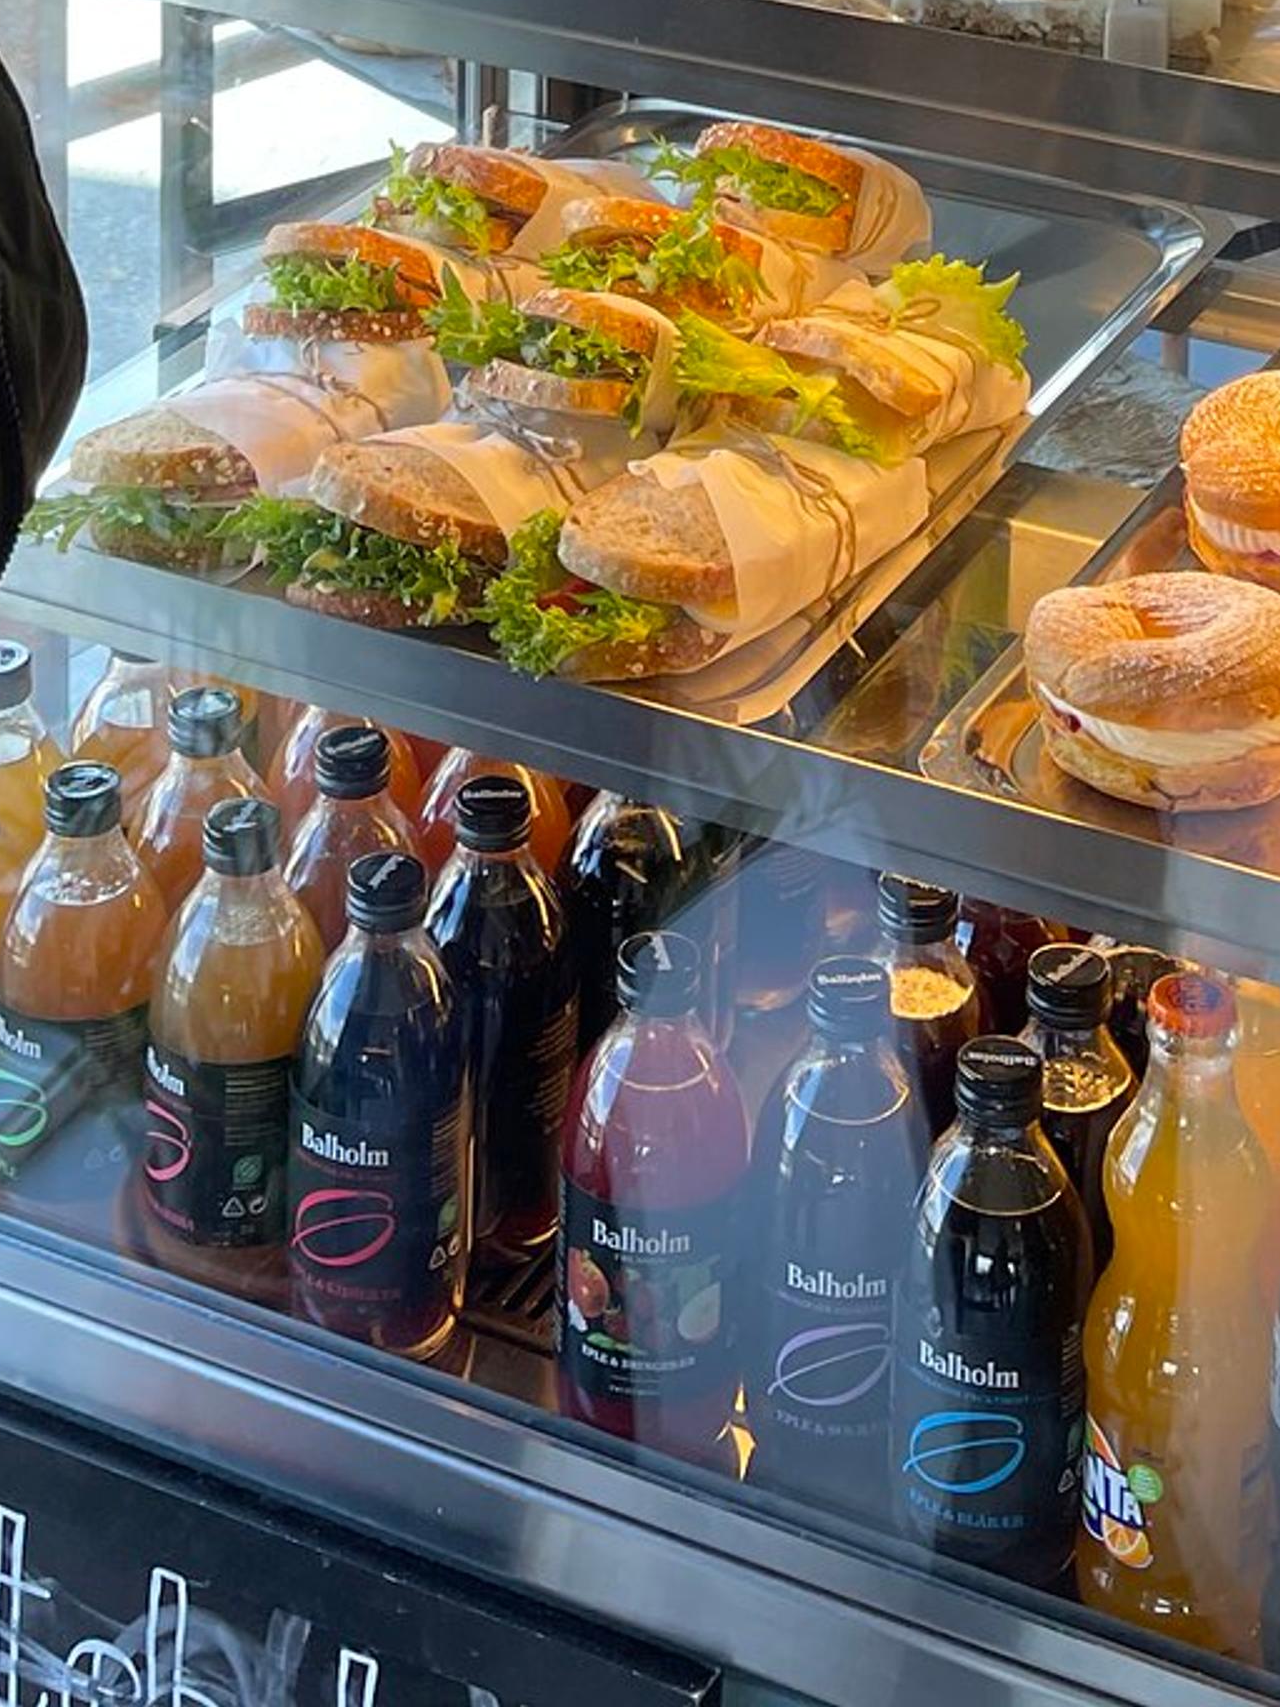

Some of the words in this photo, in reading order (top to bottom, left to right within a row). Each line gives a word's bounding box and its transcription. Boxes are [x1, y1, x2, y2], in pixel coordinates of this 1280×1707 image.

[302, 1121, 390, 1167] Balholm
[592, 1217, 691, 1255] Balholm
[786, 1261, 888, 1299] Balholm
[919, 1338, 1020, 1389] Balholm
[1082, 1450, 1144, 1527] NTA
